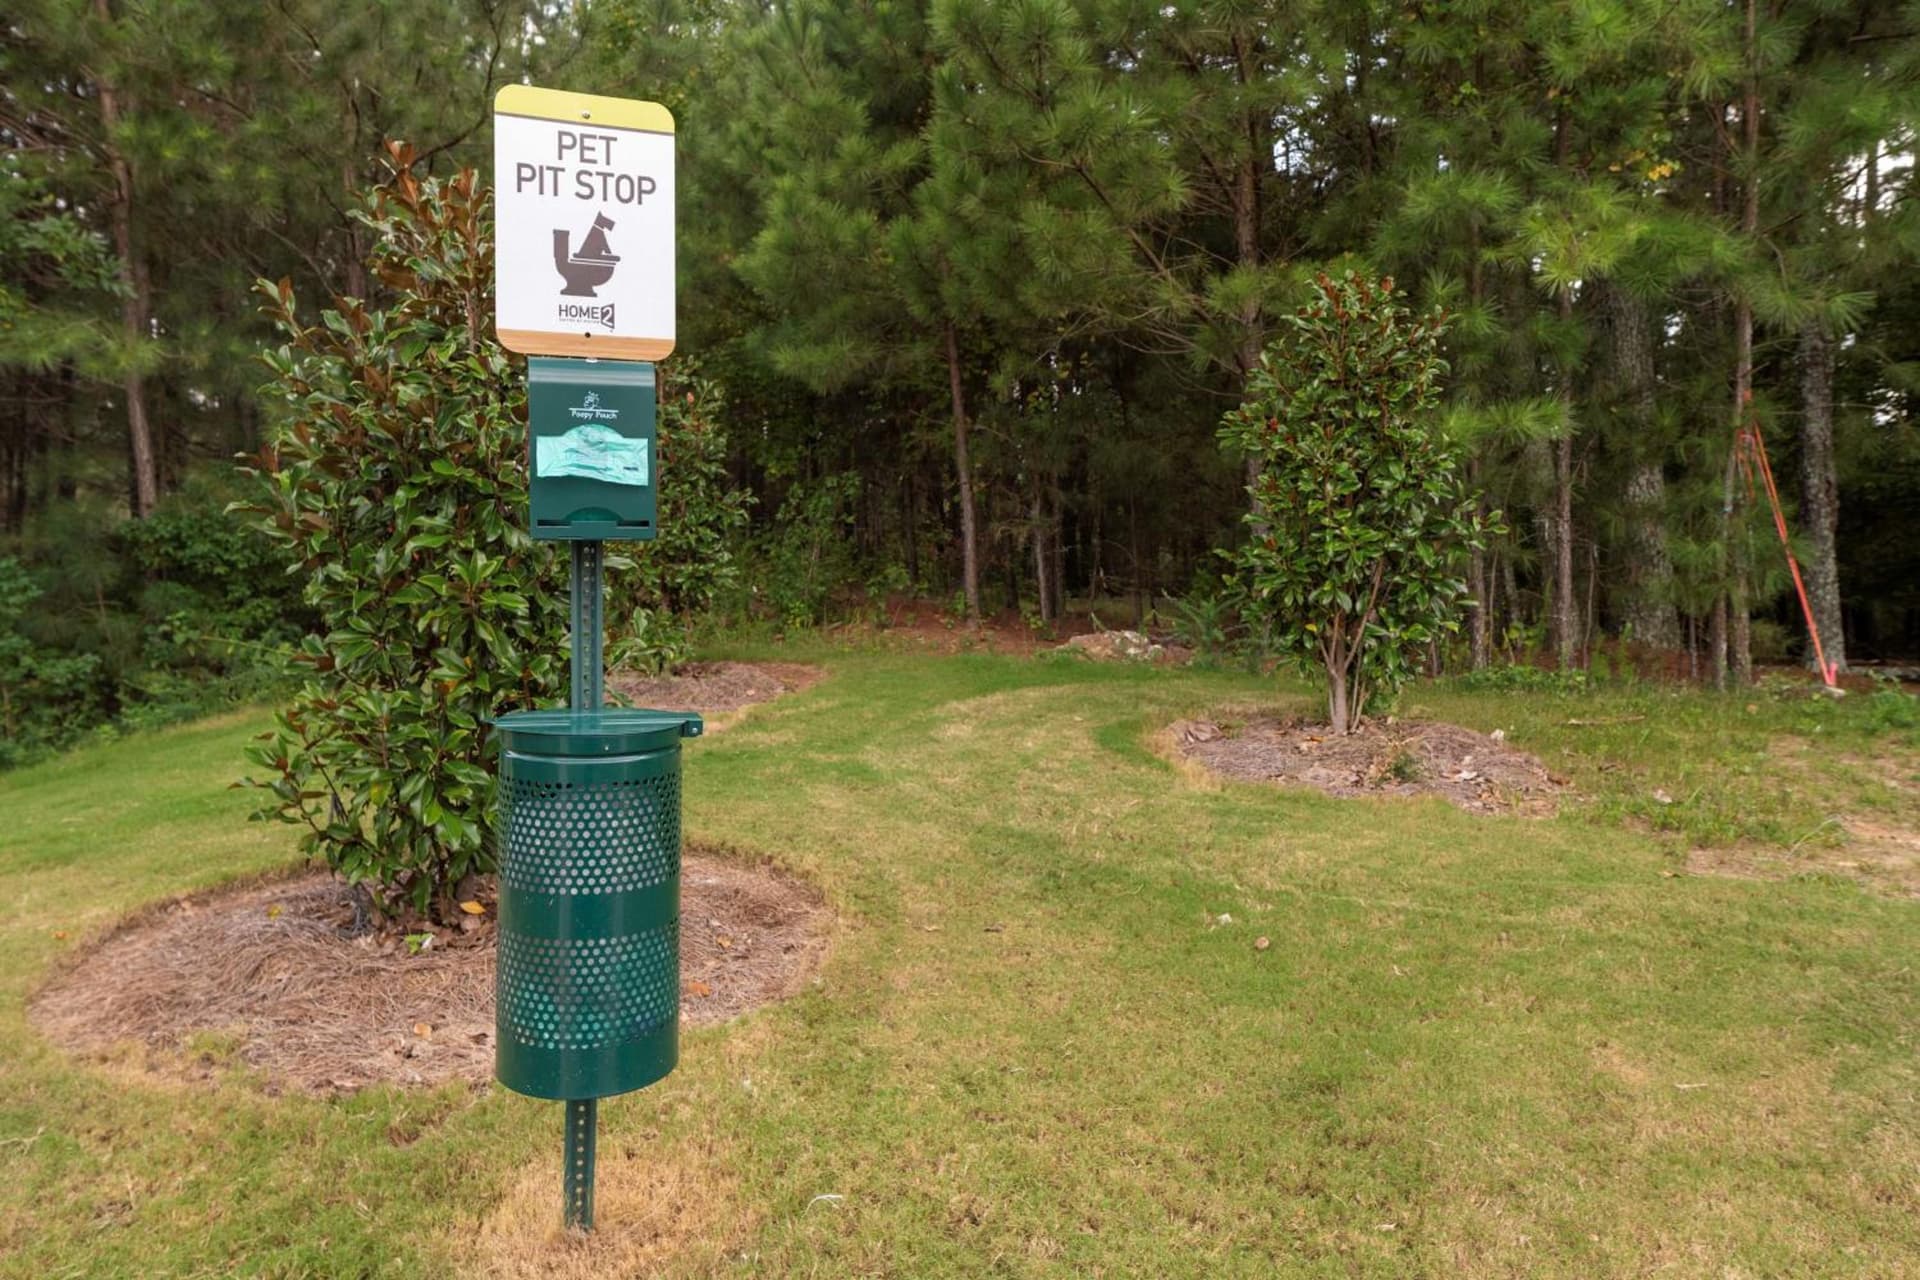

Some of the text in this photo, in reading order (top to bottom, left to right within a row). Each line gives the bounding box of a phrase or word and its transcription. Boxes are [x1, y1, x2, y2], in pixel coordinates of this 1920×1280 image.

[558, 130, 618, 166] PET
[516, 162, 656, 205] PIT STOP
